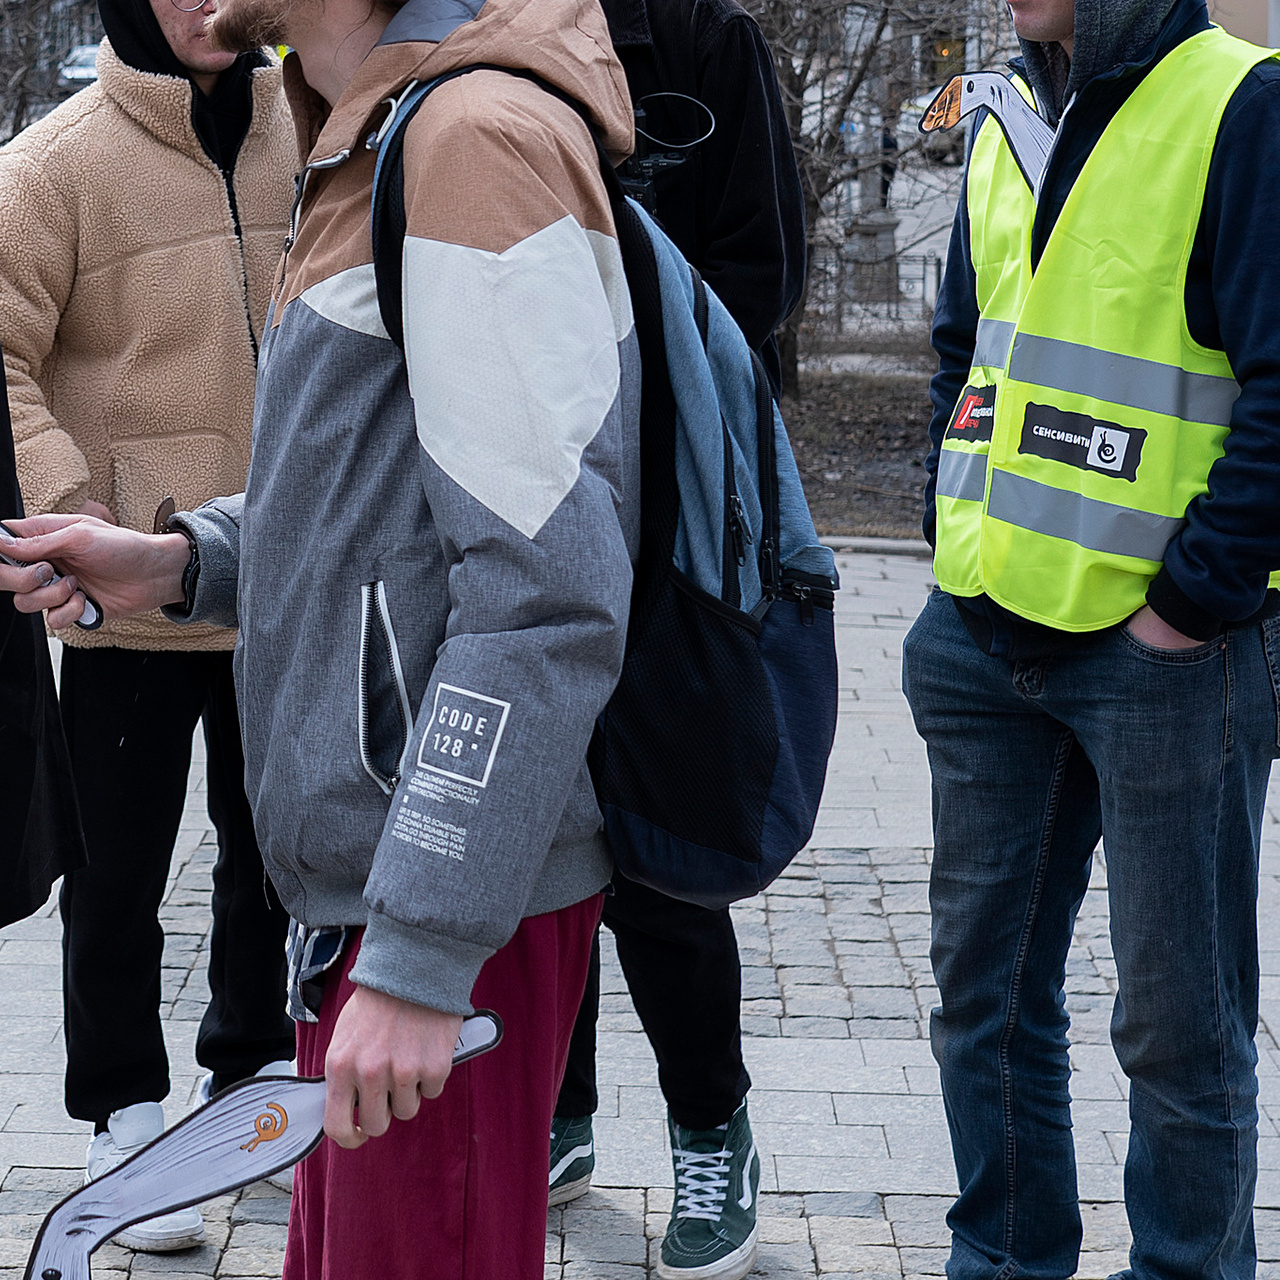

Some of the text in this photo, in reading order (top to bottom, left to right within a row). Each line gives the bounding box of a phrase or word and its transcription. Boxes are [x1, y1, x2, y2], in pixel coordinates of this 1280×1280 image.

[438, 705, 488, 737] CODE
[433, 732, 464, 758] 128
[434, 784, 480, 805] FUNCTIONALITY
[445, 781, 478, 796] PERFECTLY
[422, 815, 431, 823] SO
[431, 818, 466, 836] SOMETIMES
[409, 828, 418, 836] GO
[419, 831, 448, 847] THROUGH
[449, 842, 465, 852] PAIN
[420, 840, 447, 855] BECOME
[450, 833, 464, 843] YOU
